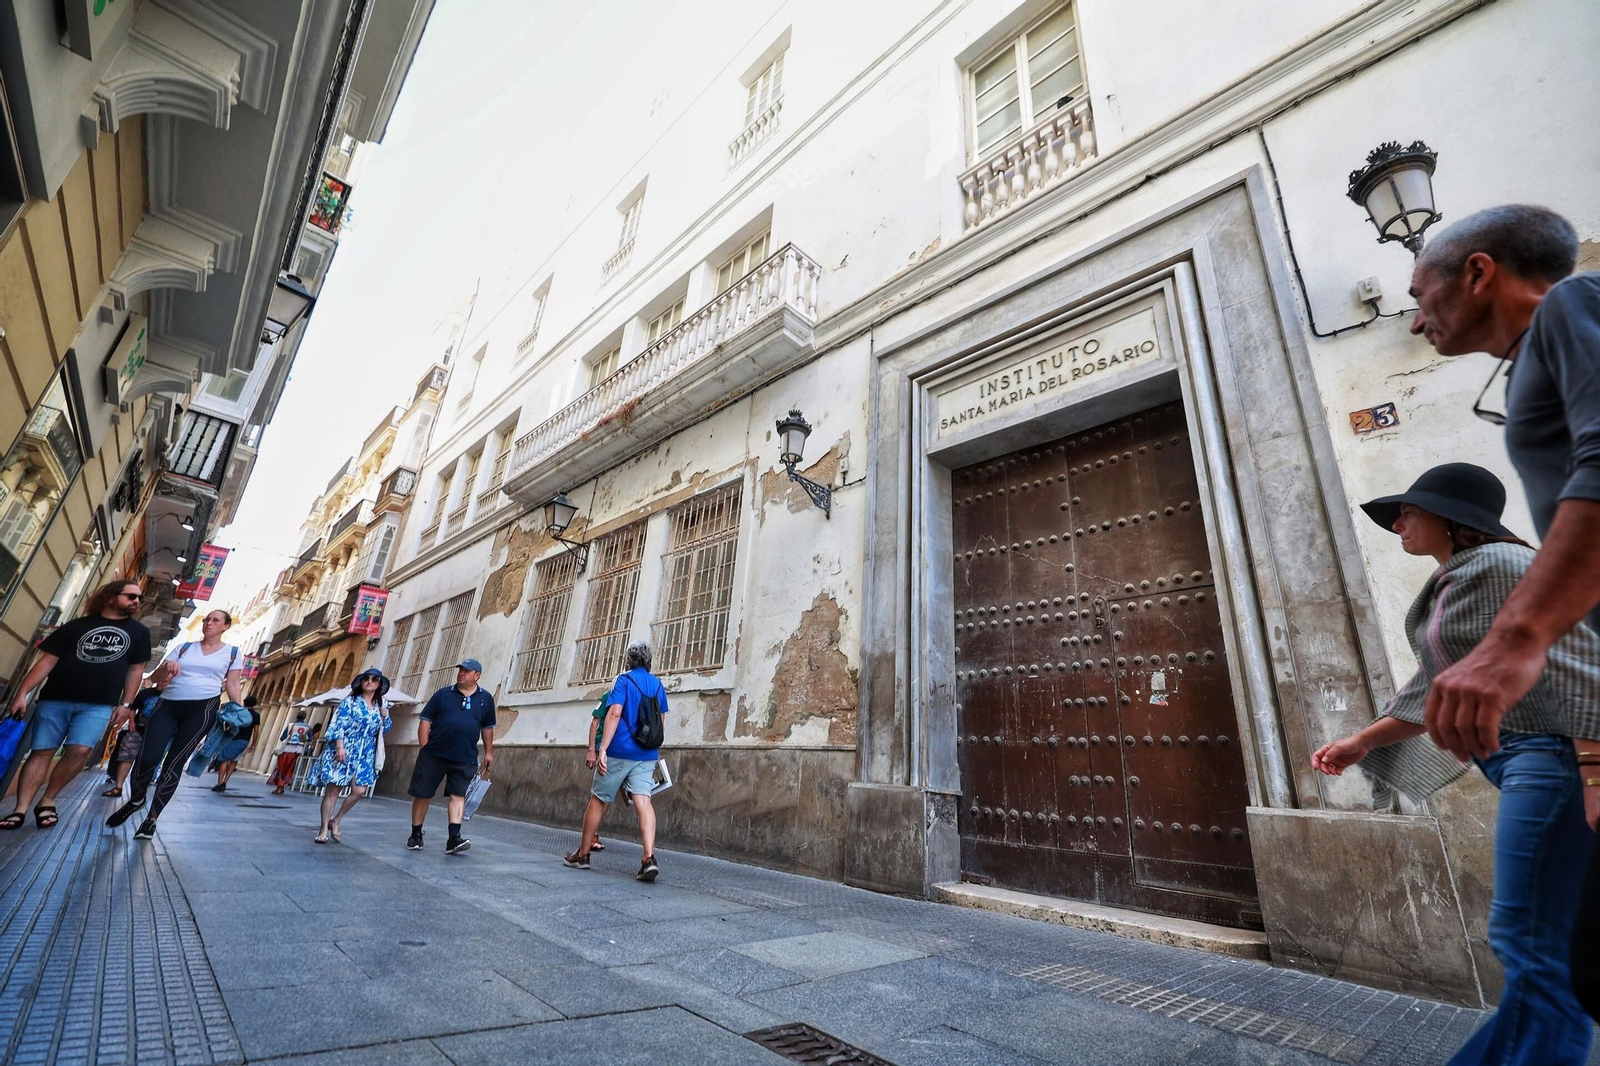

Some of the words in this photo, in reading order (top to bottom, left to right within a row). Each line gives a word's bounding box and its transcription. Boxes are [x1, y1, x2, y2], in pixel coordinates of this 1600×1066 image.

[940, 405, 985, 430] SANTA
[989, 386, 1036, 412] MARIA
[1039, 374, 1068, 394] DEL
[1071, 340, 1155, 381] ROSARIO
[979, 339, 1100, 399] INSTITUTO
[91, 634, 121, 644] DNR
